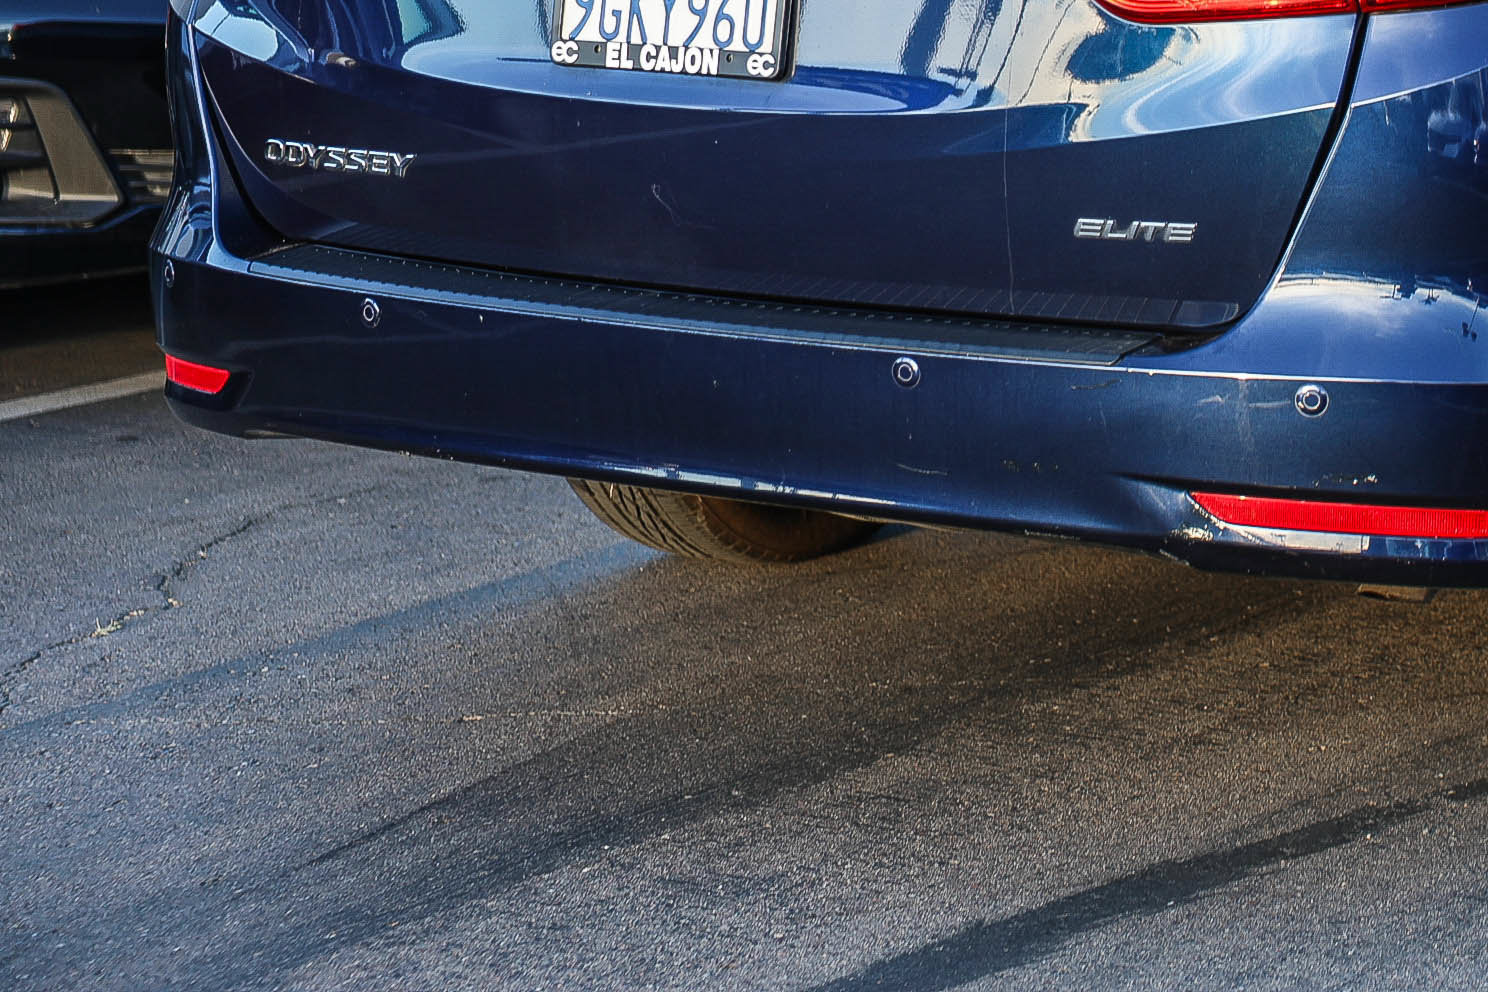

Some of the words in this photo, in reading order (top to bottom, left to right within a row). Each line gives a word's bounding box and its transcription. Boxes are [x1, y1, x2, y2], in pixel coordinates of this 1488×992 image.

[605, 41, 634, 70] EL
[639, 44, 720, 76] CAJON
[264, 138, 417, 178] ODYSSEY
[1073, 217, 1198, 244] ELITE
